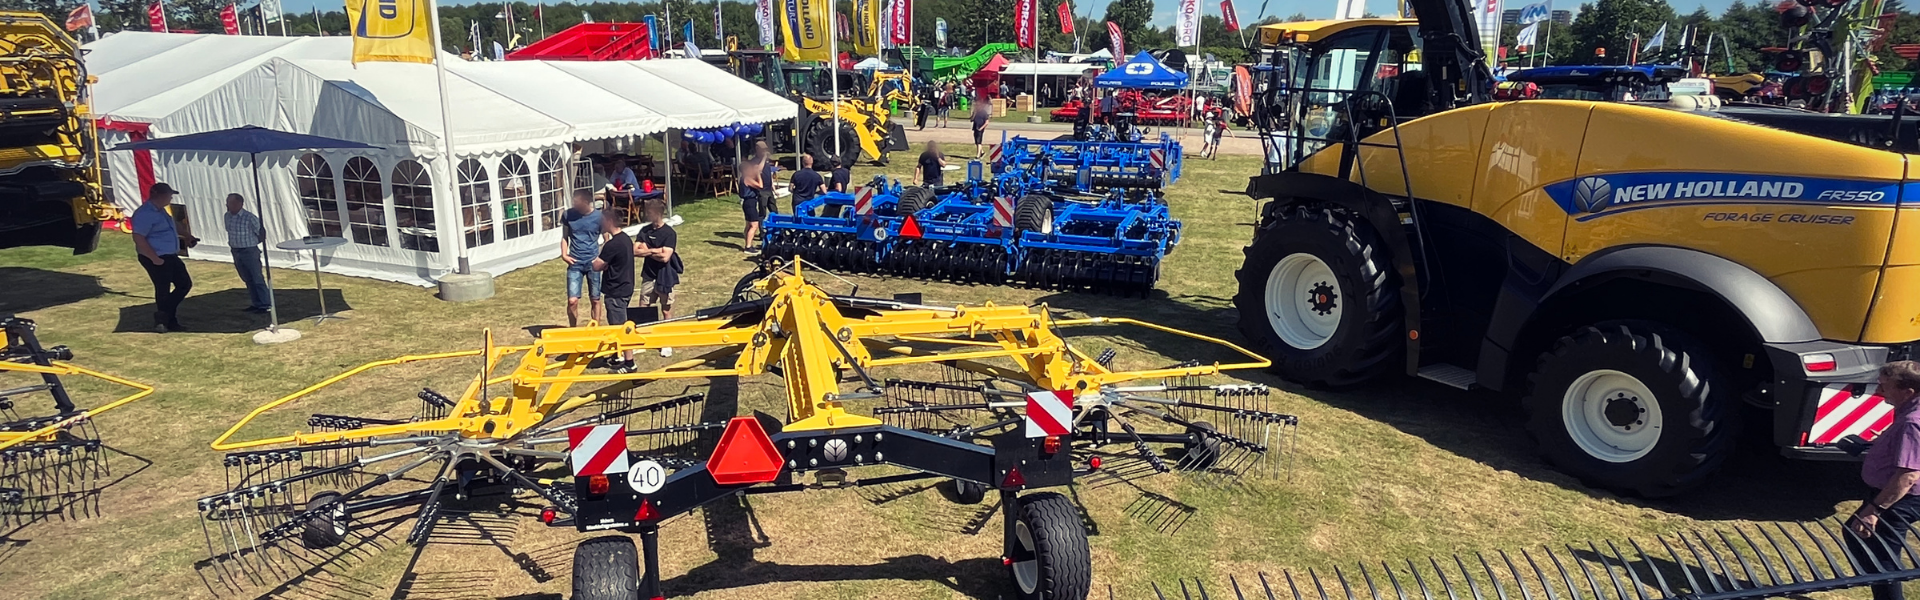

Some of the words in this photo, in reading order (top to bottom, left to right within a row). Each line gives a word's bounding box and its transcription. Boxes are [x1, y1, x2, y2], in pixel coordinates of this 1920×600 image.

[1020, 0, 1029, 44] ORSCH
[1614, 182, 1671, 204] NEW
[1674, 181, 1804, 199] HOLLAND
[1817, 189, 1885, 202] FR550
[1703, 212, 1773, 223] FORAGE
[1777, 213, 1856, 225] CRUISER
[632, 466, 660, 487] 40
